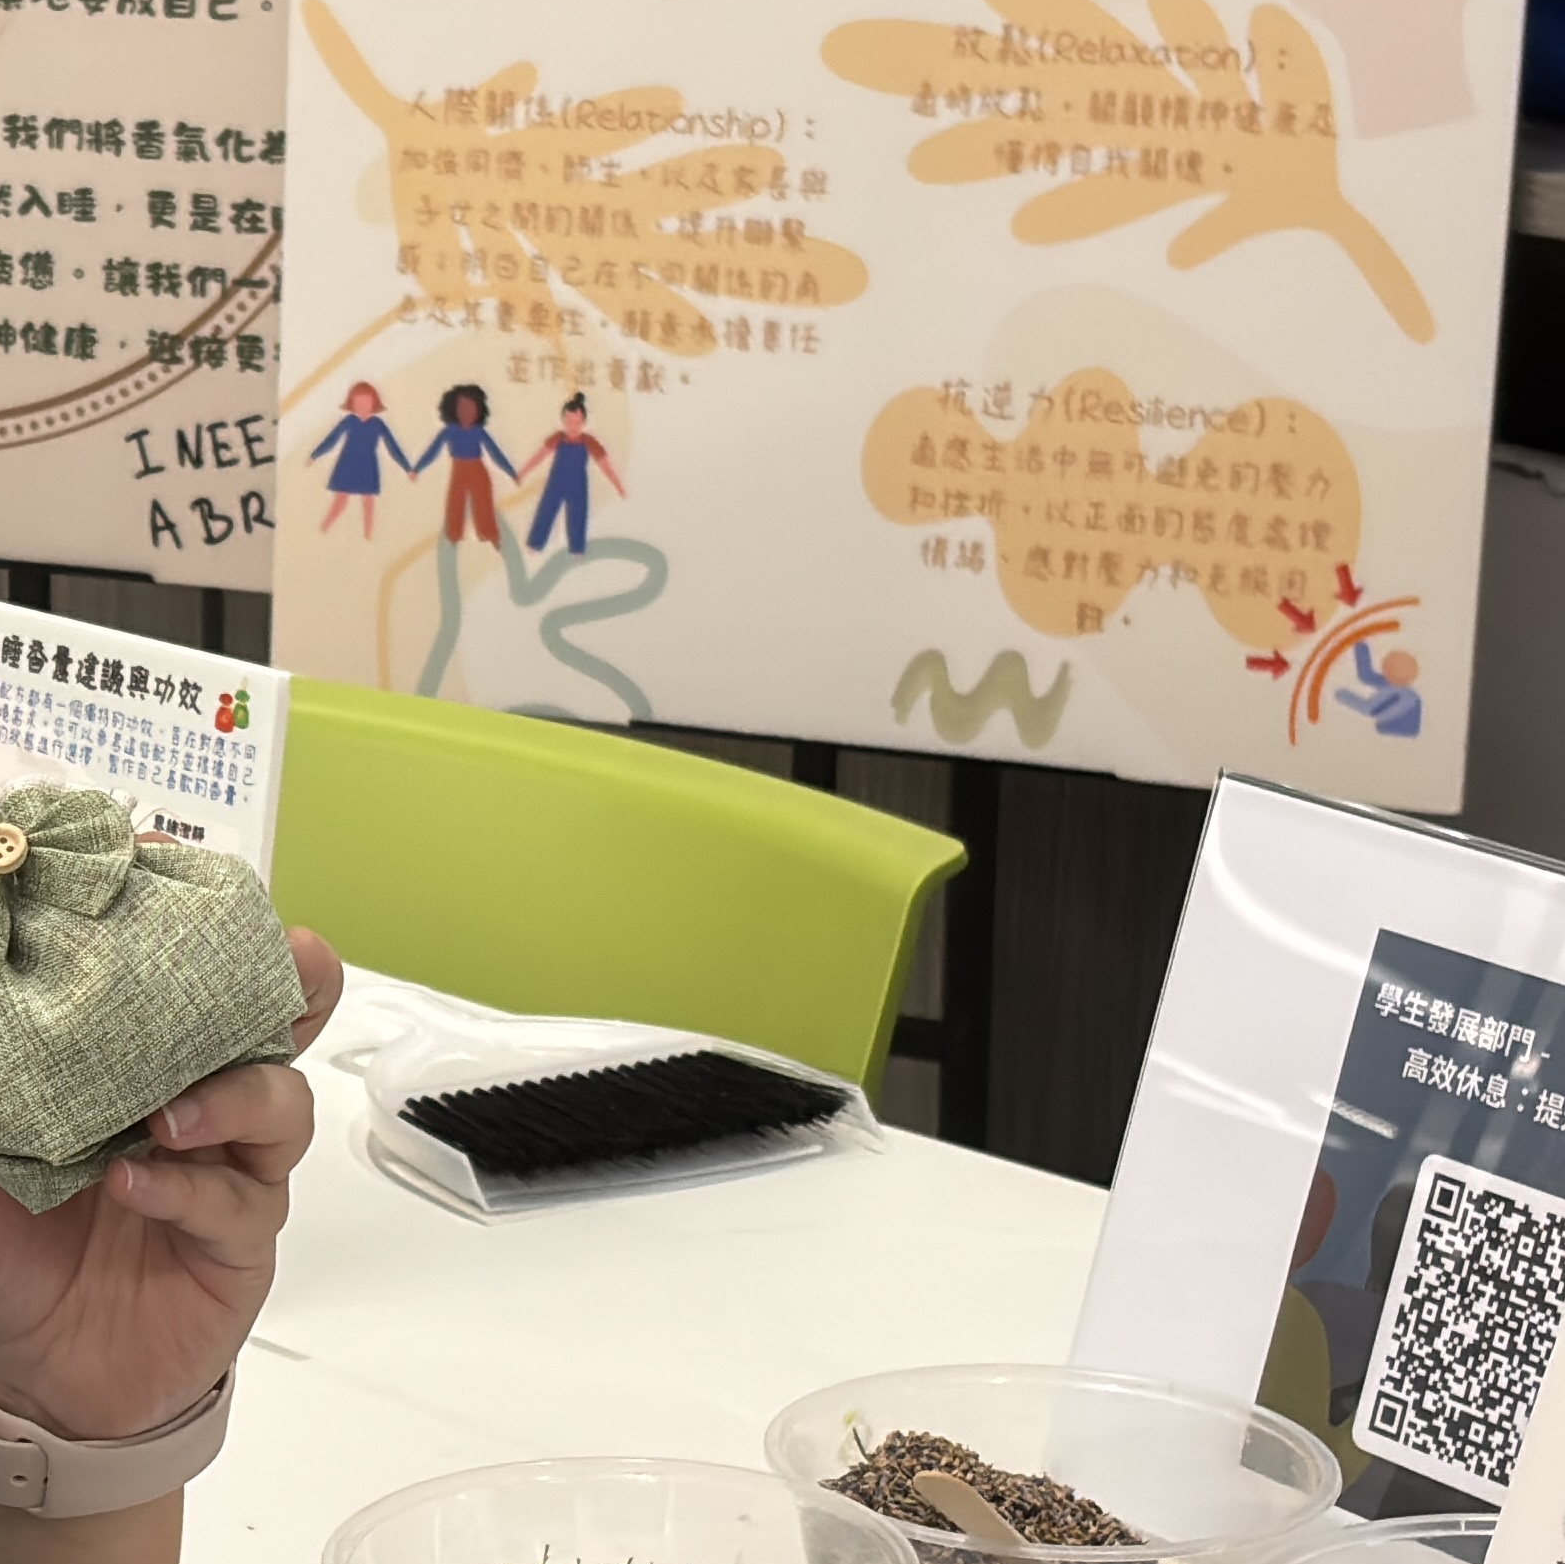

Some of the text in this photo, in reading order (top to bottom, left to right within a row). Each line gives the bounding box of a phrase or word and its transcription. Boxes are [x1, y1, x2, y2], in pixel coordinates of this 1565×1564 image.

[124, 414, 277, 479] I NEE
[1373, 981, 1536, 1063] 學生發展部門
